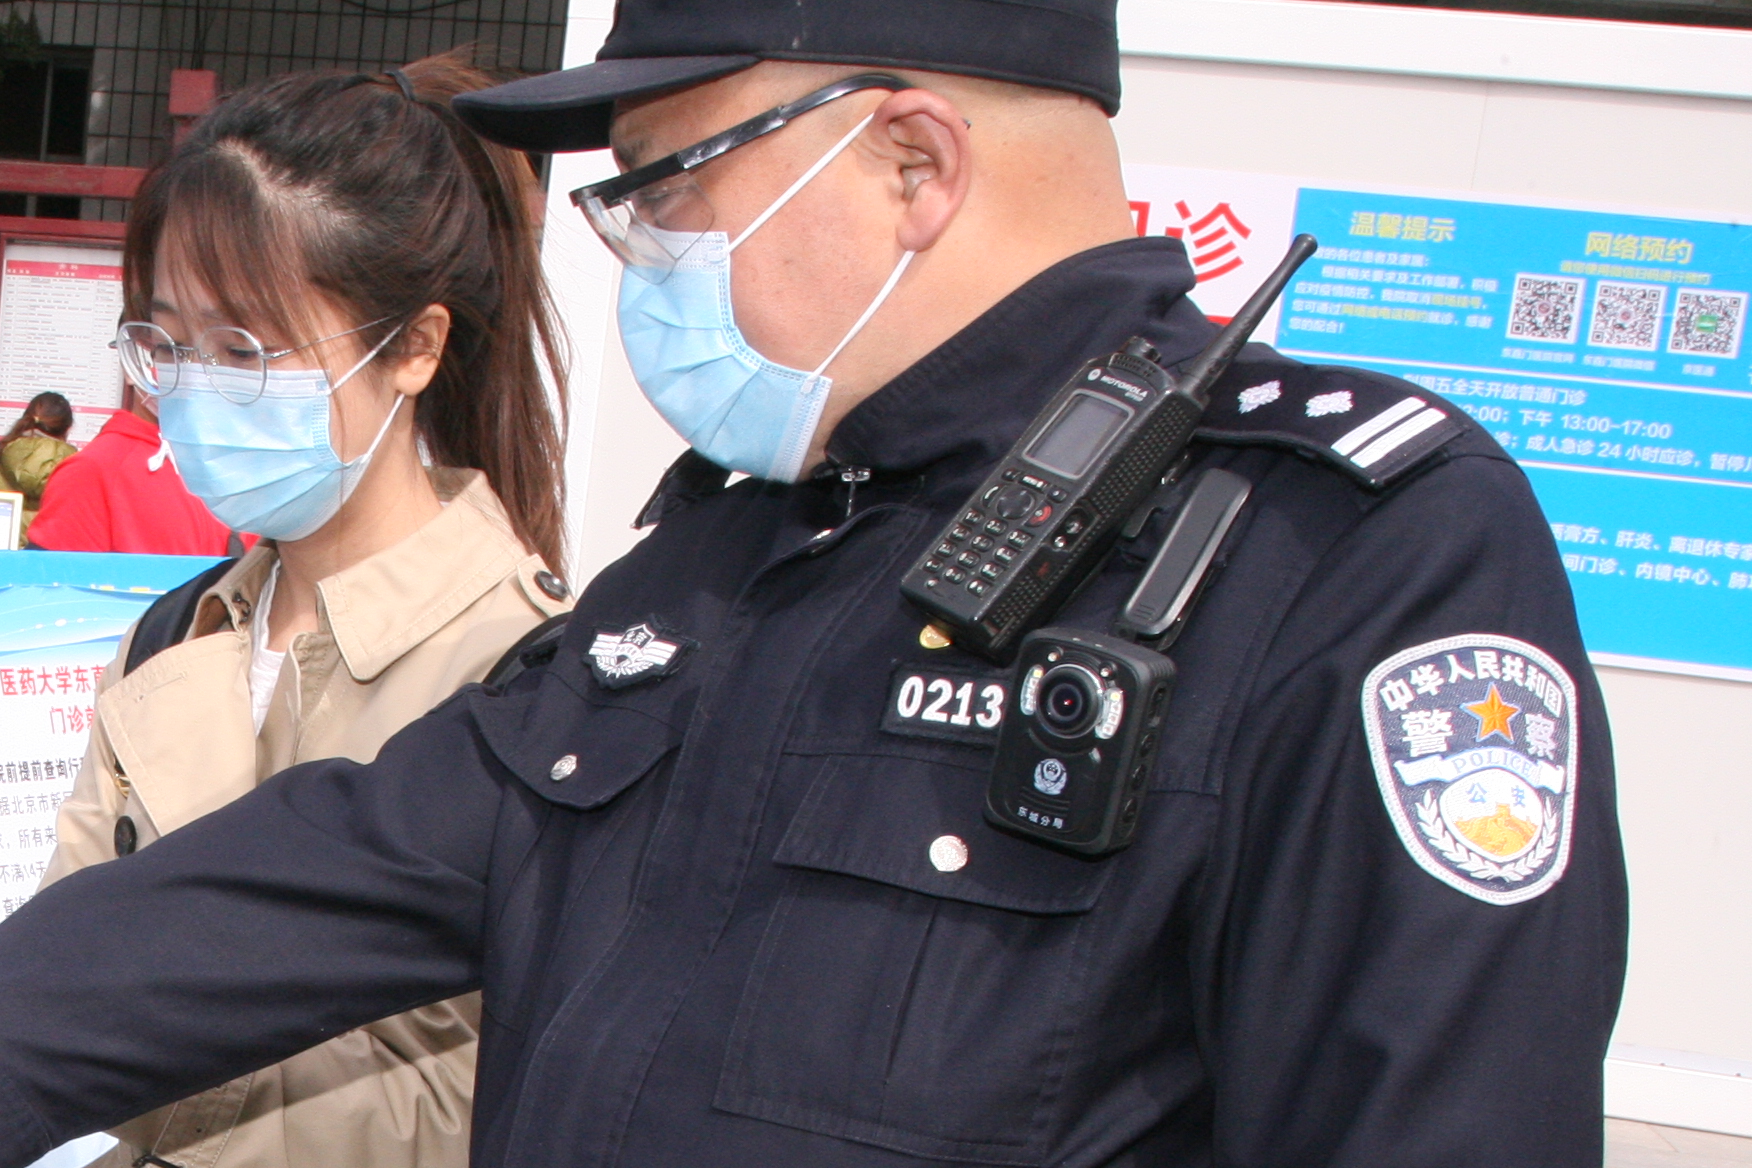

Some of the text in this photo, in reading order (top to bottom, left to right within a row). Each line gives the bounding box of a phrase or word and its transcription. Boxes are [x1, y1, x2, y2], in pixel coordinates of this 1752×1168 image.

[1129, 199, 1252, 284] 诊
[1350, 211, 1456, 242] 温馨提示
[1585, 231, 1694, 264] 网络预约
[1099, 375, 1149, 398] MOTOROLA
[1379, 650, 1564, 718] 中华人民共和国
[897, 675, 1005, 729] 0213
[1453, 752, 1534, 778] POLICE
[1017, 805, 1064, 830] 东城分局
